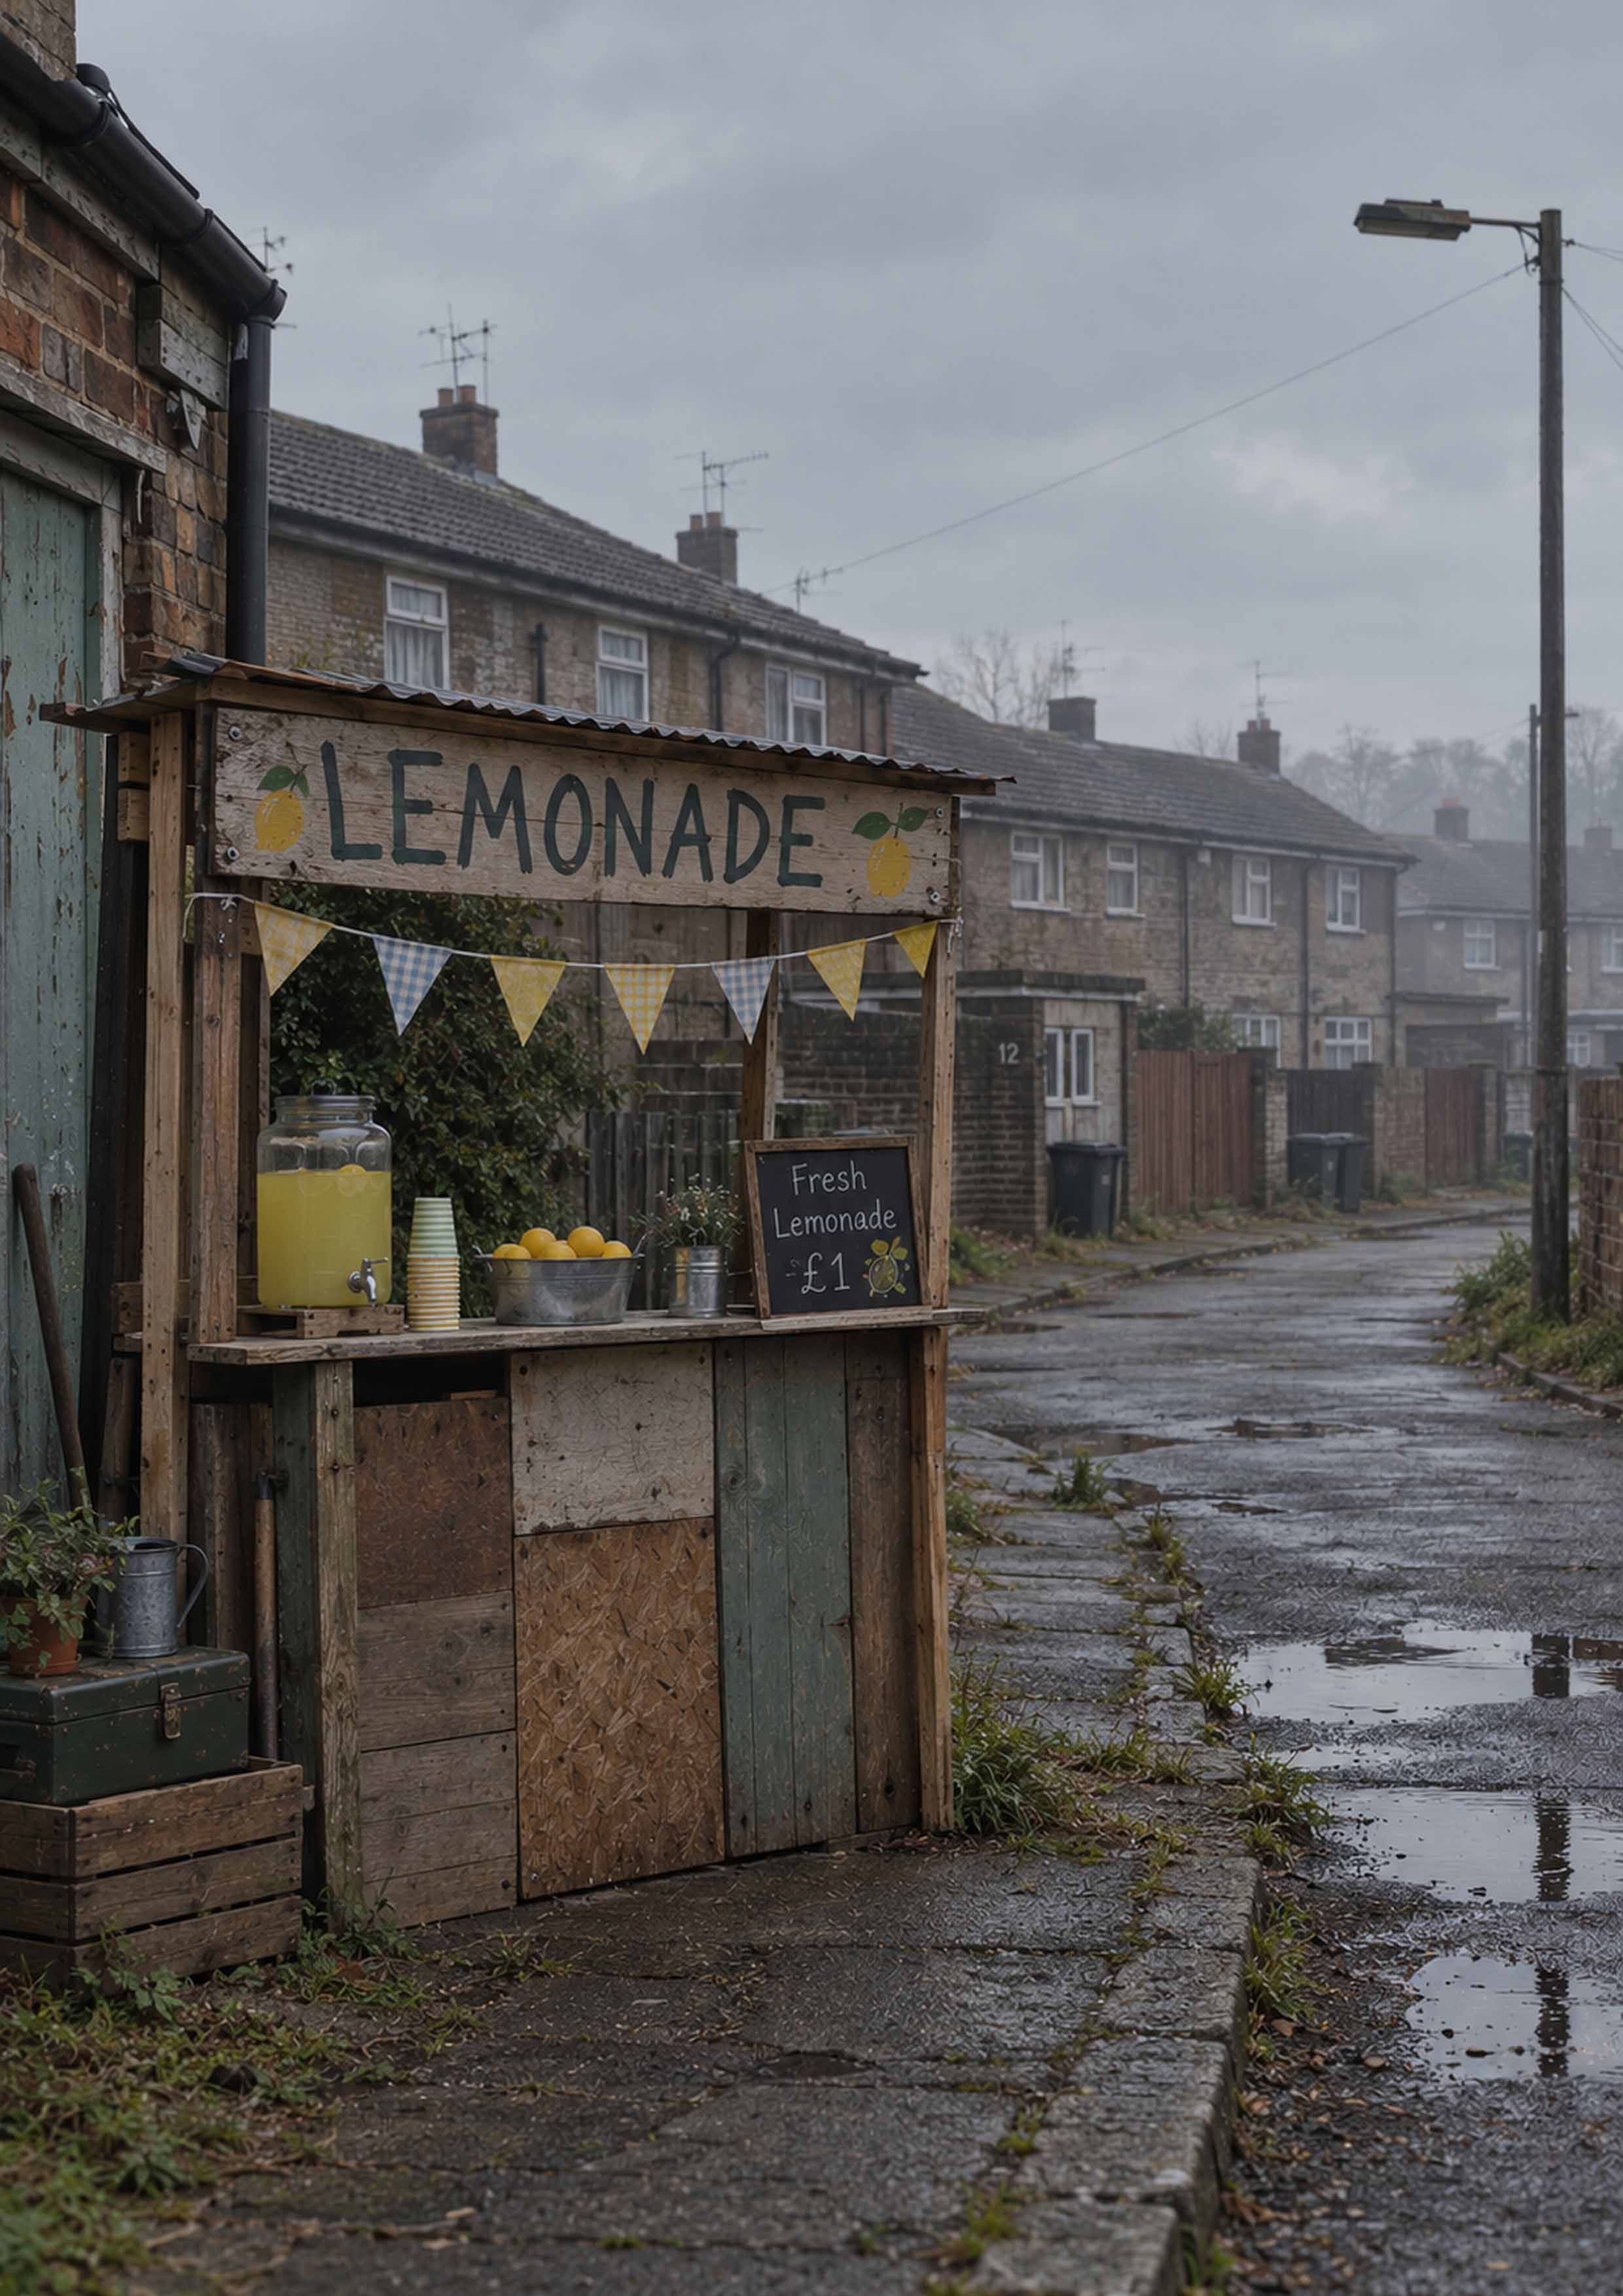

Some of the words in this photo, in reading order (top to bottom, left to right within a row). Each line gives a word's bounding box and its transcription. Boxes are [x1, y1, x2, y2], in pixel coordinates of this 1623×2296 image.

[320, 740, 826, 888] LEMONADE
[998, 1043, 1020, 1064] 12
[791, 1159, 867, 1196] Fresh
[773, 1198, 897, 1238] Lemonade
[800, 1251, 850, 1295] £1
